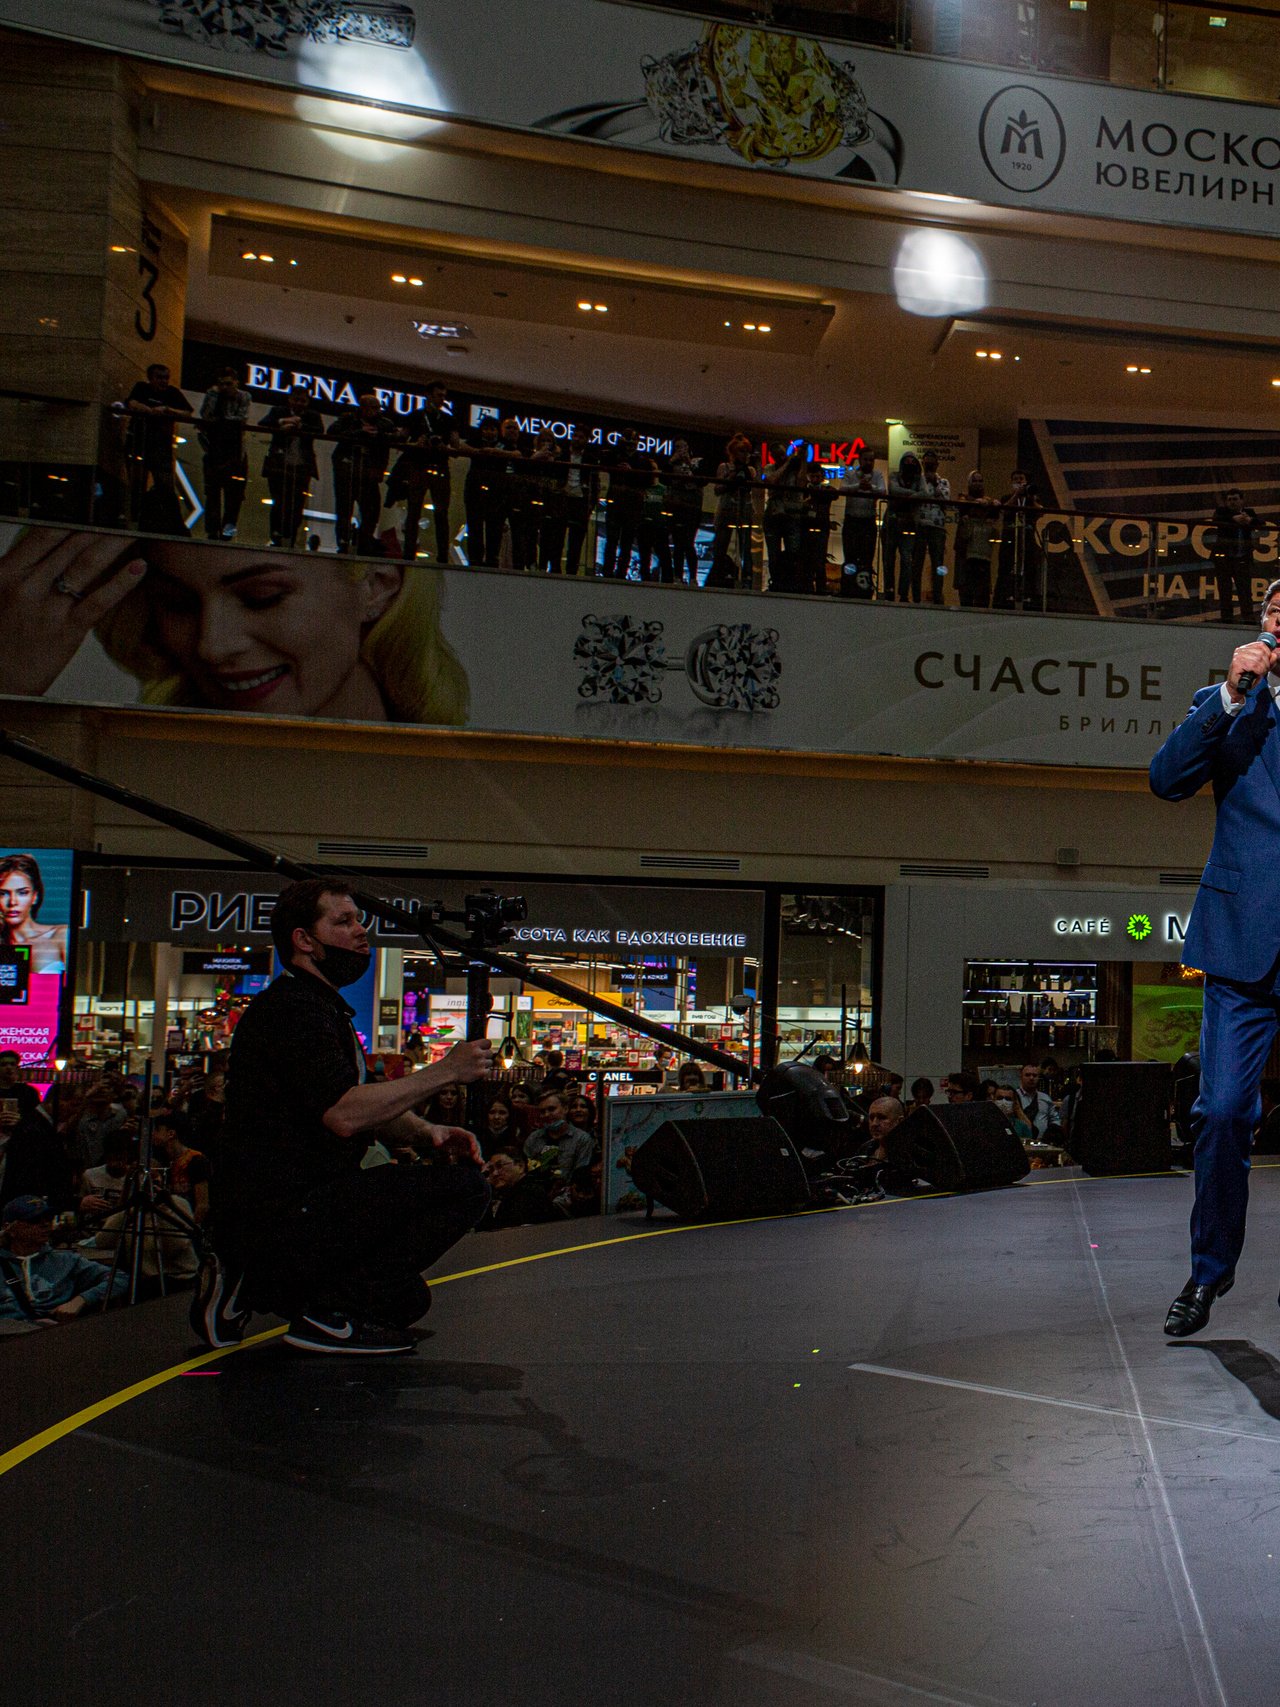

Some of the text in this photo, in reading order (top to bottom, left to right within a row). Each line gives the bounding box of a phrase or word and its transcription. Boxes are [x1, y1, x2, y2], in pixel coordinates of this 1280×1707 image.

[1011, 161, 1033, 171] 1920
[245, 362, 361, 408] ELENA
[1144, 573, 1191, 600] НА
[914, 651, 1163, 701] СЧАСТЬЕ
[1056, 918, 1110, 934] CAFÉ
[573, 929, 611, 944] КАК
[616, 930, 747, 947] ВДОХНОВЕНИЕ
[588, 1072, 634, 1082] CANEL
